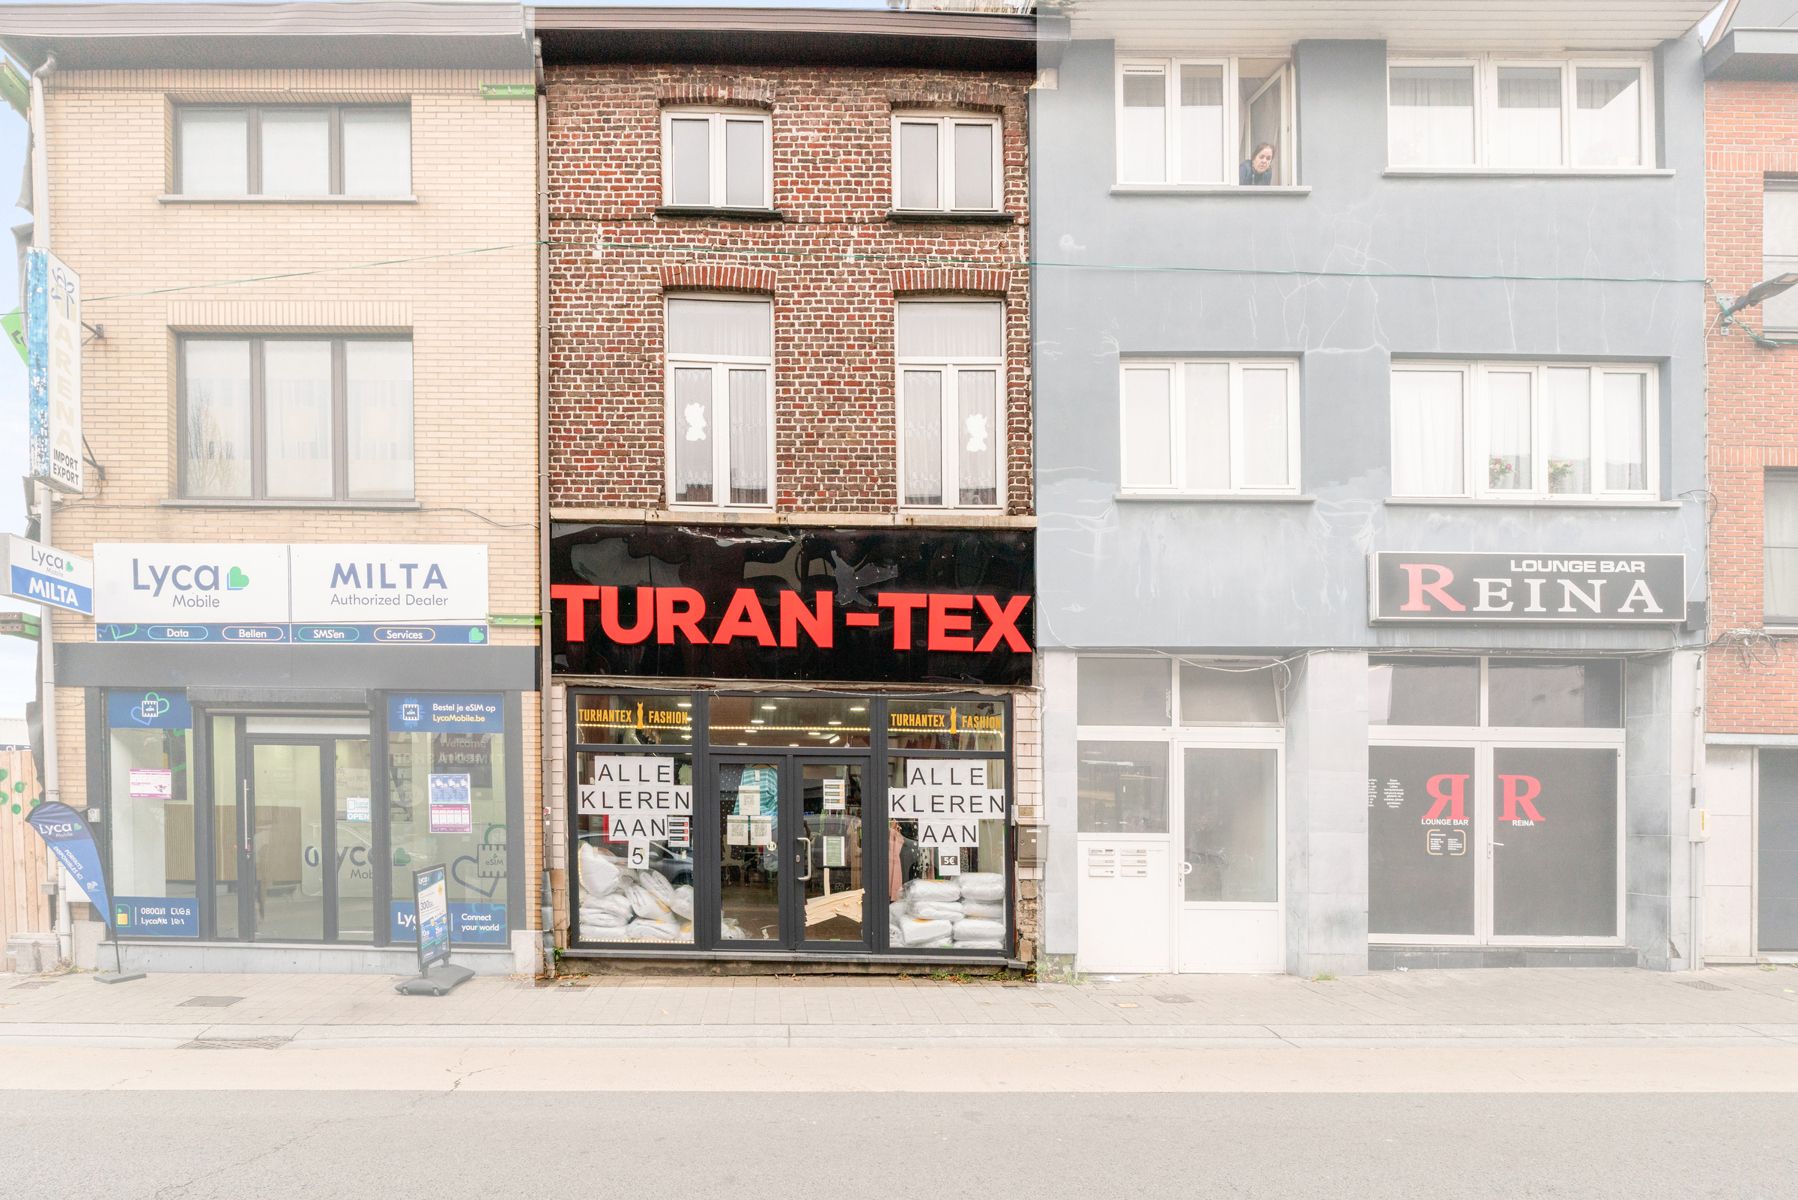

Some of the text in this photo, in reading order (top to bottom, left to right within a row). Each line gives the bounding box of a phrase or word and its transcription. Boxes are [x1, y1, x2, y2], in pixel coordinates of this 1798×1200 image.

[54, 322, 73, 452] ARENA
[53, 448, 78, 471] IMPORT
[53, 463, 79, 486] EXPORT
[31, 545, 64, 570] Lyca
[1510, 559, 1646, 574] LOUNGE BAR
[132, 558, 220, 597] Lyca
[330, 562, 448, 590] MILTA
[28, 577, 79, 607] MILTA
[1399, 563, 1664, 614] REINA
[172, 594, 220, 608] Mobile
[330, 593, 448, 607] Authorized Dealer
[167, 628, 189, 639] Data
[238, 628, 267, 639] Bellen
[386, 629, 424, 640] Services
[432, 703, 496, 713] Bestel je eSIM op
[578, 708, 688, 724] TURHANTEX FASHION
[432, 714, 486, 723] LycaMobile.be
[890, 713, 1001, 729] TURHANTEX FASHION
[598, 763, 671, 783] ALLE
[910, 767, 984, 786] ALLE
[581, 790, 690, 810] KLEREN
[891, 794, 1005, 813] KLEREN
[1498, 774, 1546, 821] R
[39, 822, 73, 836] Lyca
[612, 818, 666, 837] AAN
[1421, 818, 1453, 826] LOUNGE
[1512, 819, 1535, 827] REINA
[922, 825, 977, 843] AAN
[631, 847, 644, 865] 5
[943, 856, 955, 865] 5€
[461, 913, 491, 922] Connect
[461, 923, 499, 932] your world
